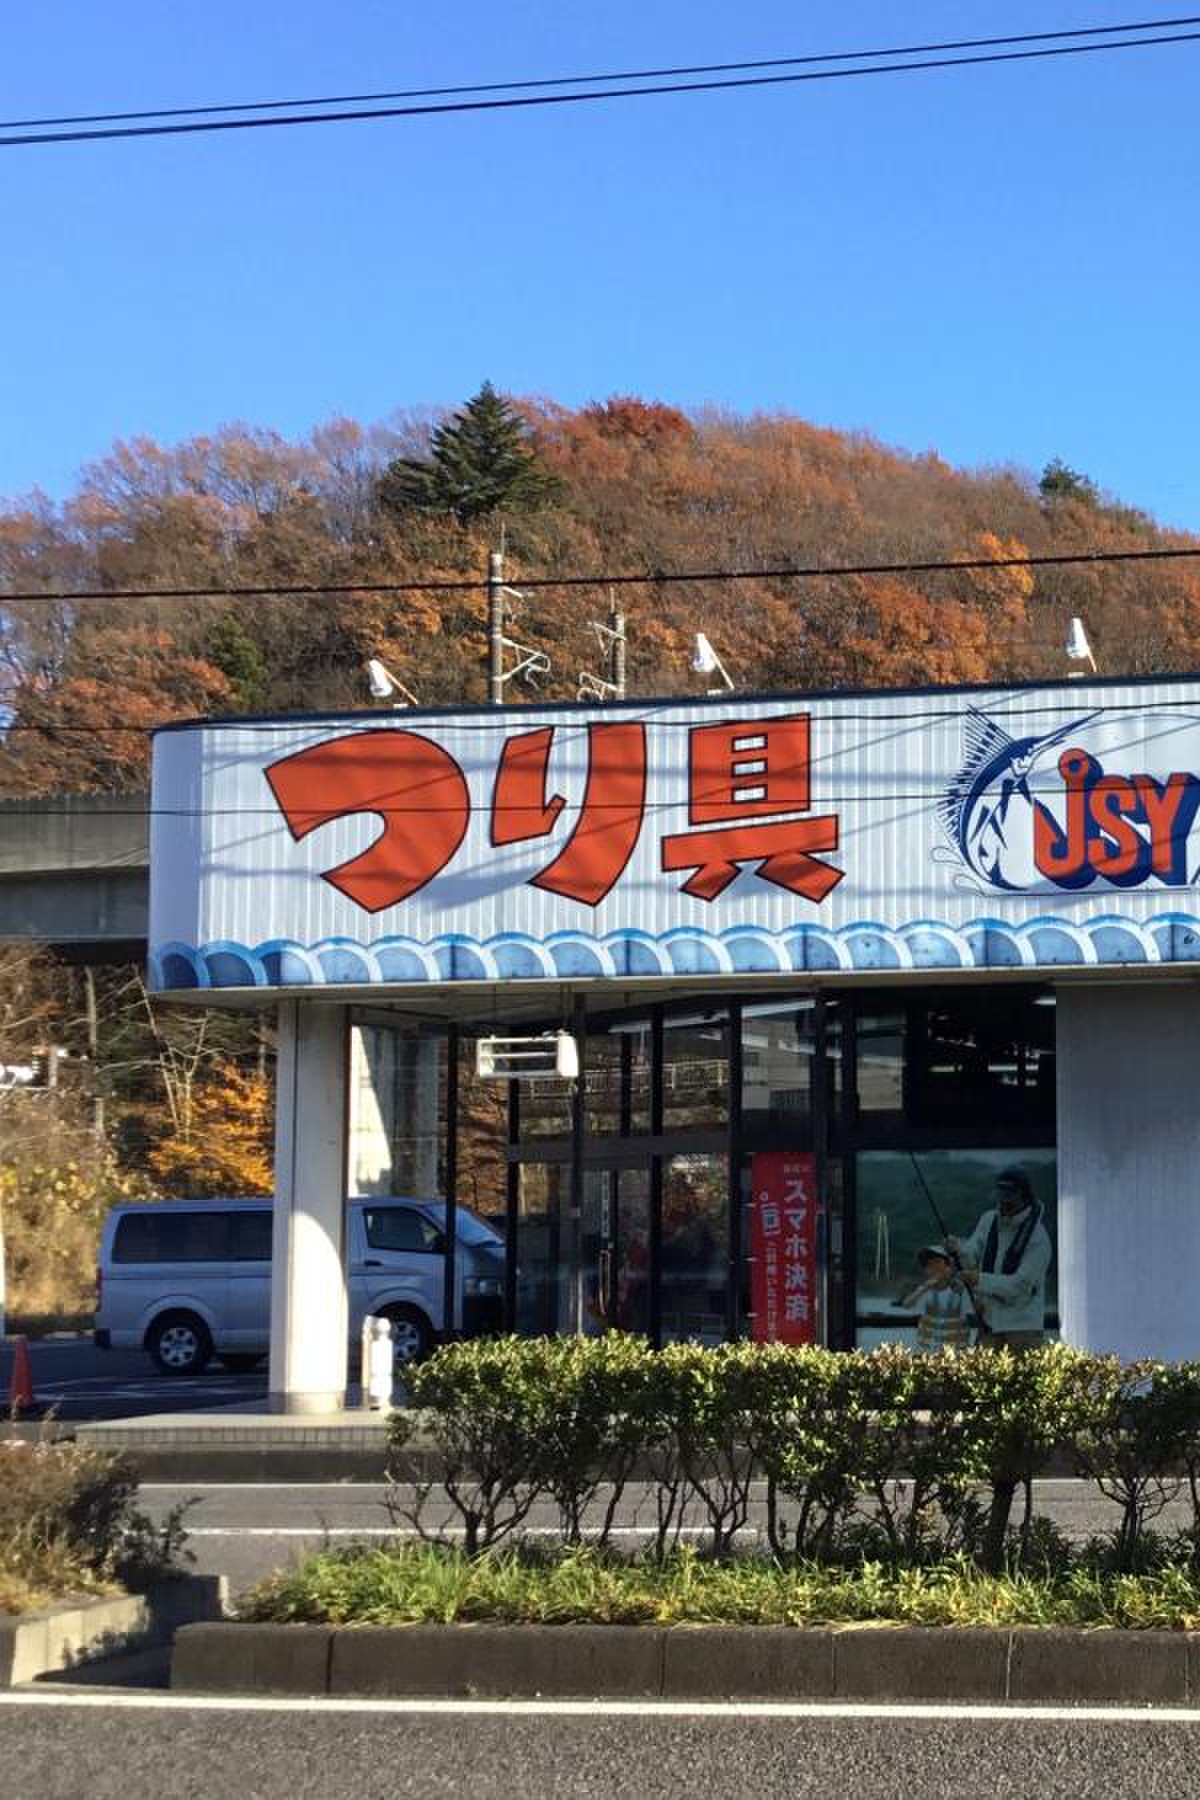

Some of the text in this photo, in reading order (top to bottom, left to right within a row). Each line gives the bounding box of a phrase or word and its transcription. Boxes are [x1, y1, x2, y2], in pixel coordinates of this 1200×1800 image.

[262, 712, 845, 914] つり具
[783, 1178, 810, 1322] スマホ決済
